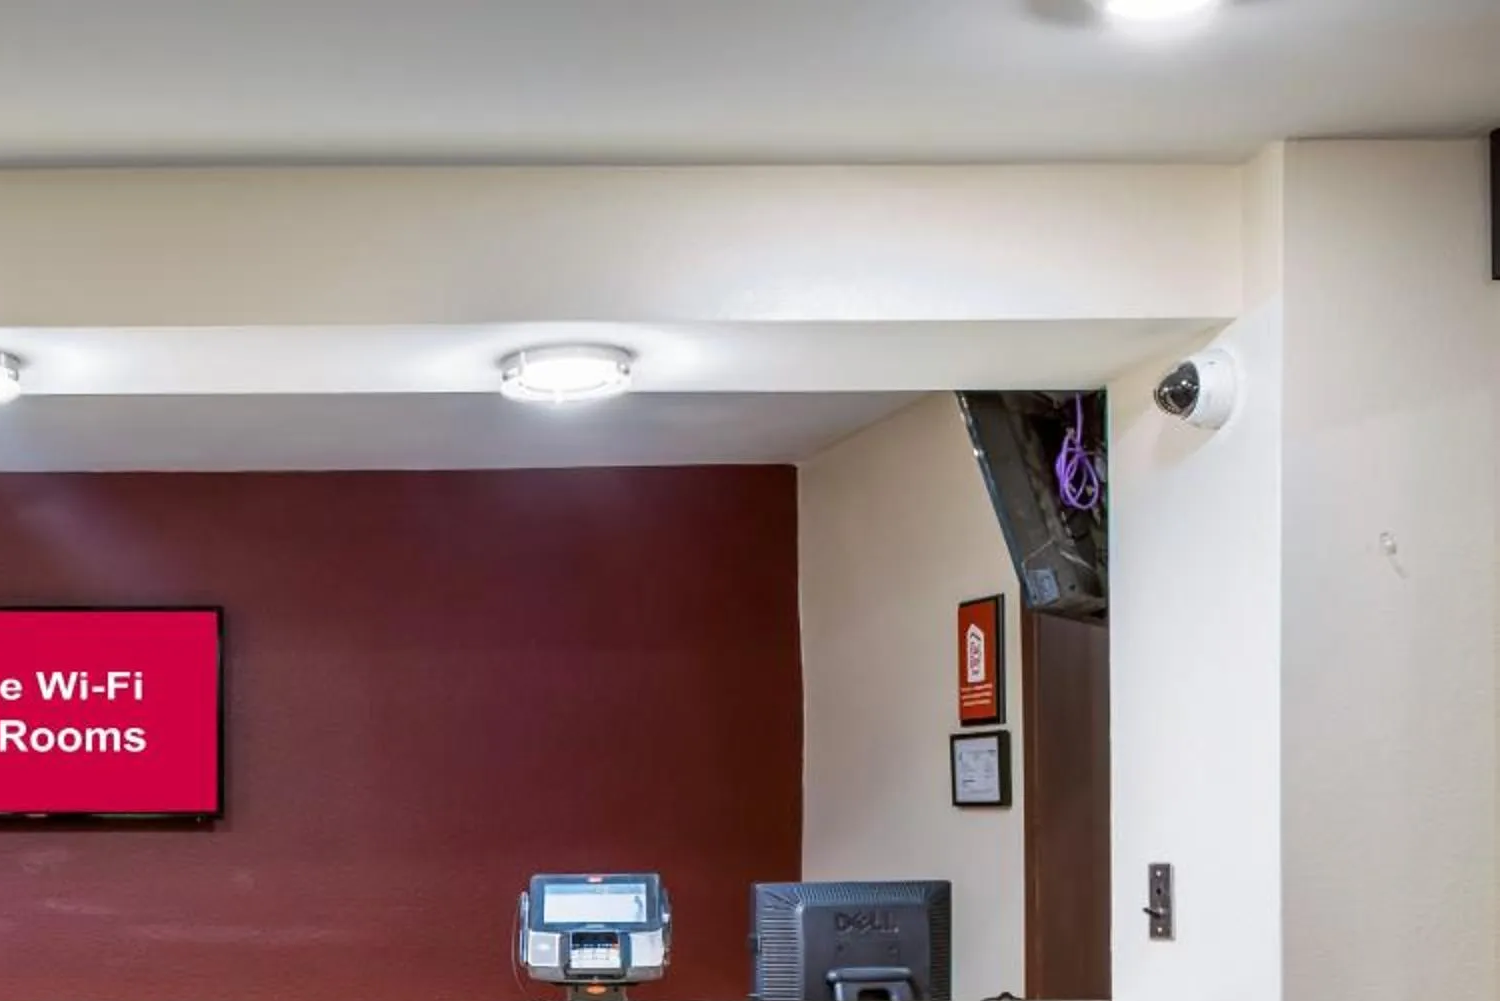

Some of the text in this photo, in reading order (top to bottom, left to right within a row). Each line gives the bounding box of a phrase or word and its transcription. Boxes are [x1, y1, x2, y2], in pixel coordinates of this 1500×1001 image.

[35, 671, 143, 701] Wi-Fi
[0, 719, 147, 753] Rooms
[833, 910, 899, 932] DELL
